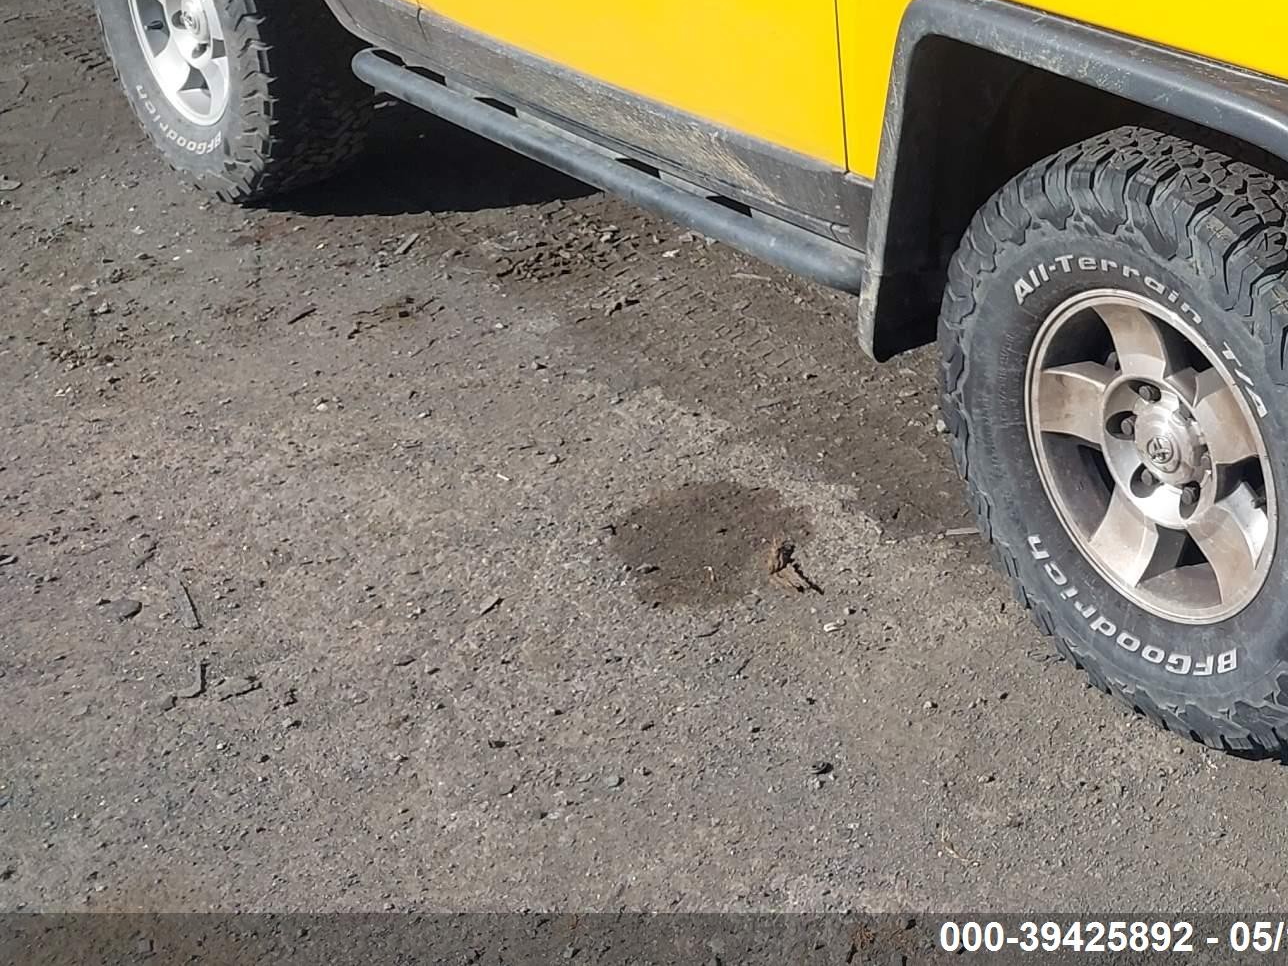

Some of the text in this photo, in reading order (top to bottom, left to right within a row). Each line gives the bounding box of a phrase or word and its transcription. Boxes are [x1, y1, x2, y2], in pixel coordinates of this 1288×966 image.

[135, 84, 222, 155] BFGoodrich
[1013, 253, 1269, 419] All-Terrain T/A
[1027, 534, 1239, 677] BFGoodrich
